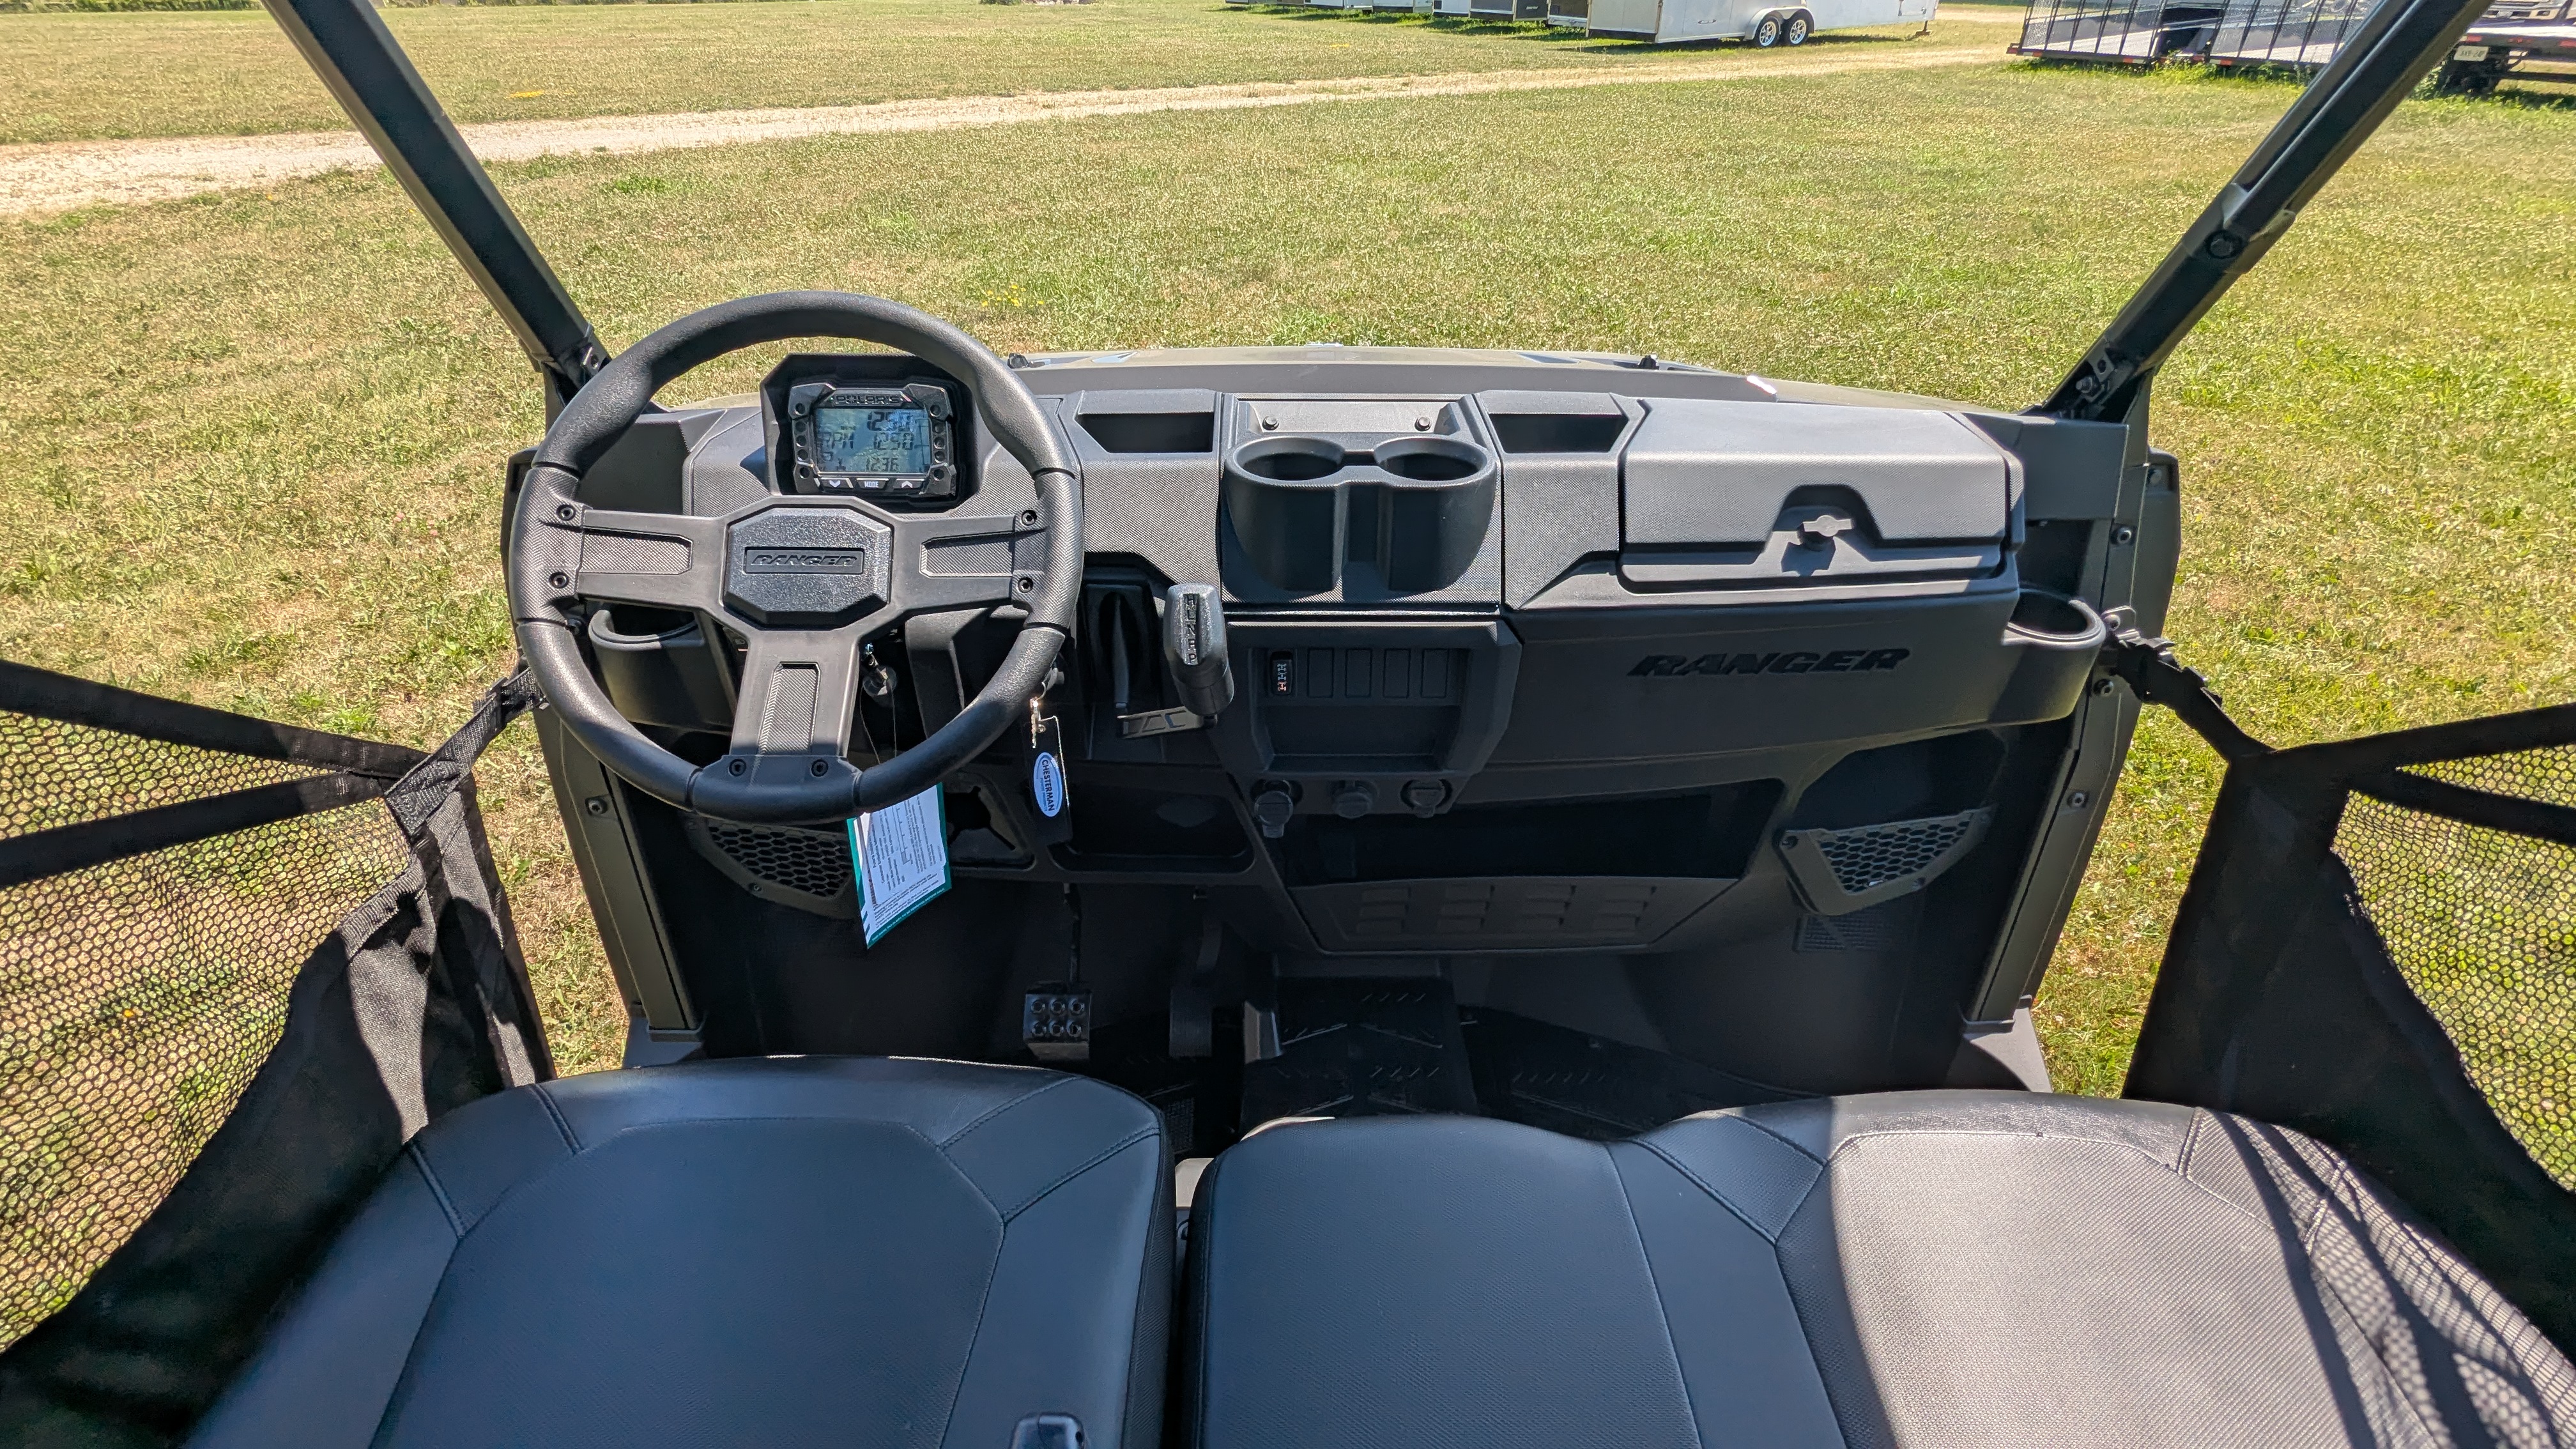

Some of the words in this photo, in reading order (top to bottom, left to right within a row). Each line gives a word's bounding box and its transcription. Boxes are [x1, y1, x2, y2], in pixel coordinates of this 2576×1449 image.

[834, 394, 901, 405] POLARIS
[750, 554, 858, 567] RANGER
[1626, 647, 1910, 677] RANGER
[1041, 759, 1055, 811] CHESTERMAN
